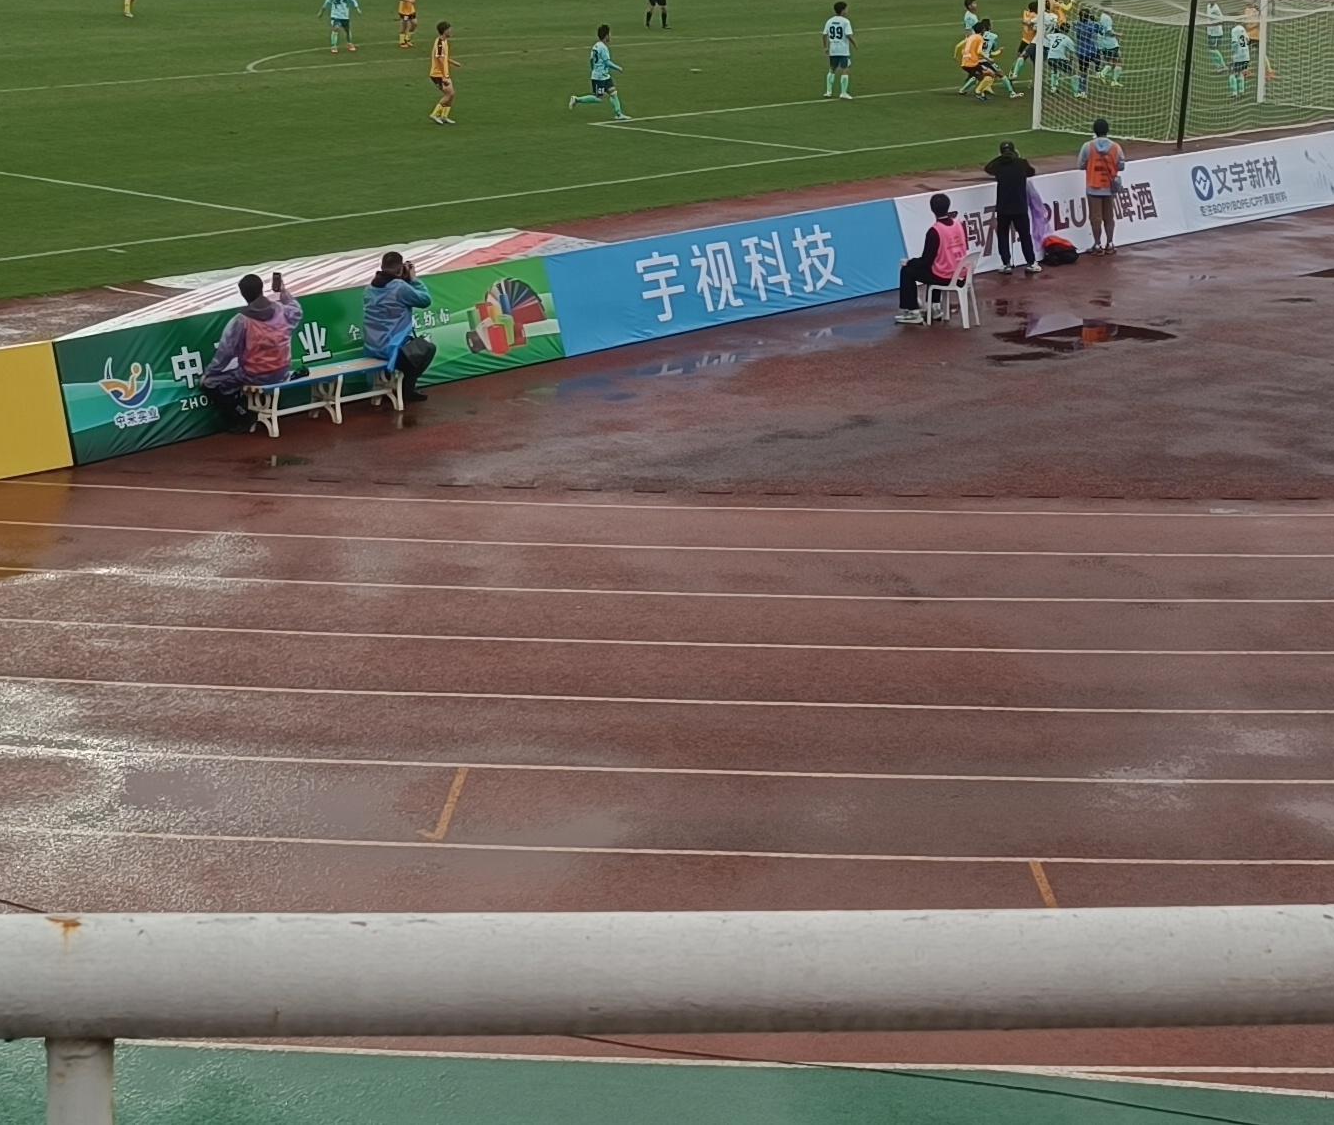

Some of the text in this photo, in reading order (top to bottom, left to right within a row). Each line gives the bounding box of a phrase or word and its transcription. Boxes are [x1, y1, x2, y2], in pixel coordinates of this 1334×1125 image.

[829, 25, 843, 40] 99
[1211, 155, 1282, 195] 文宇新材
[636, 224, 843, 322] 宇视科技
